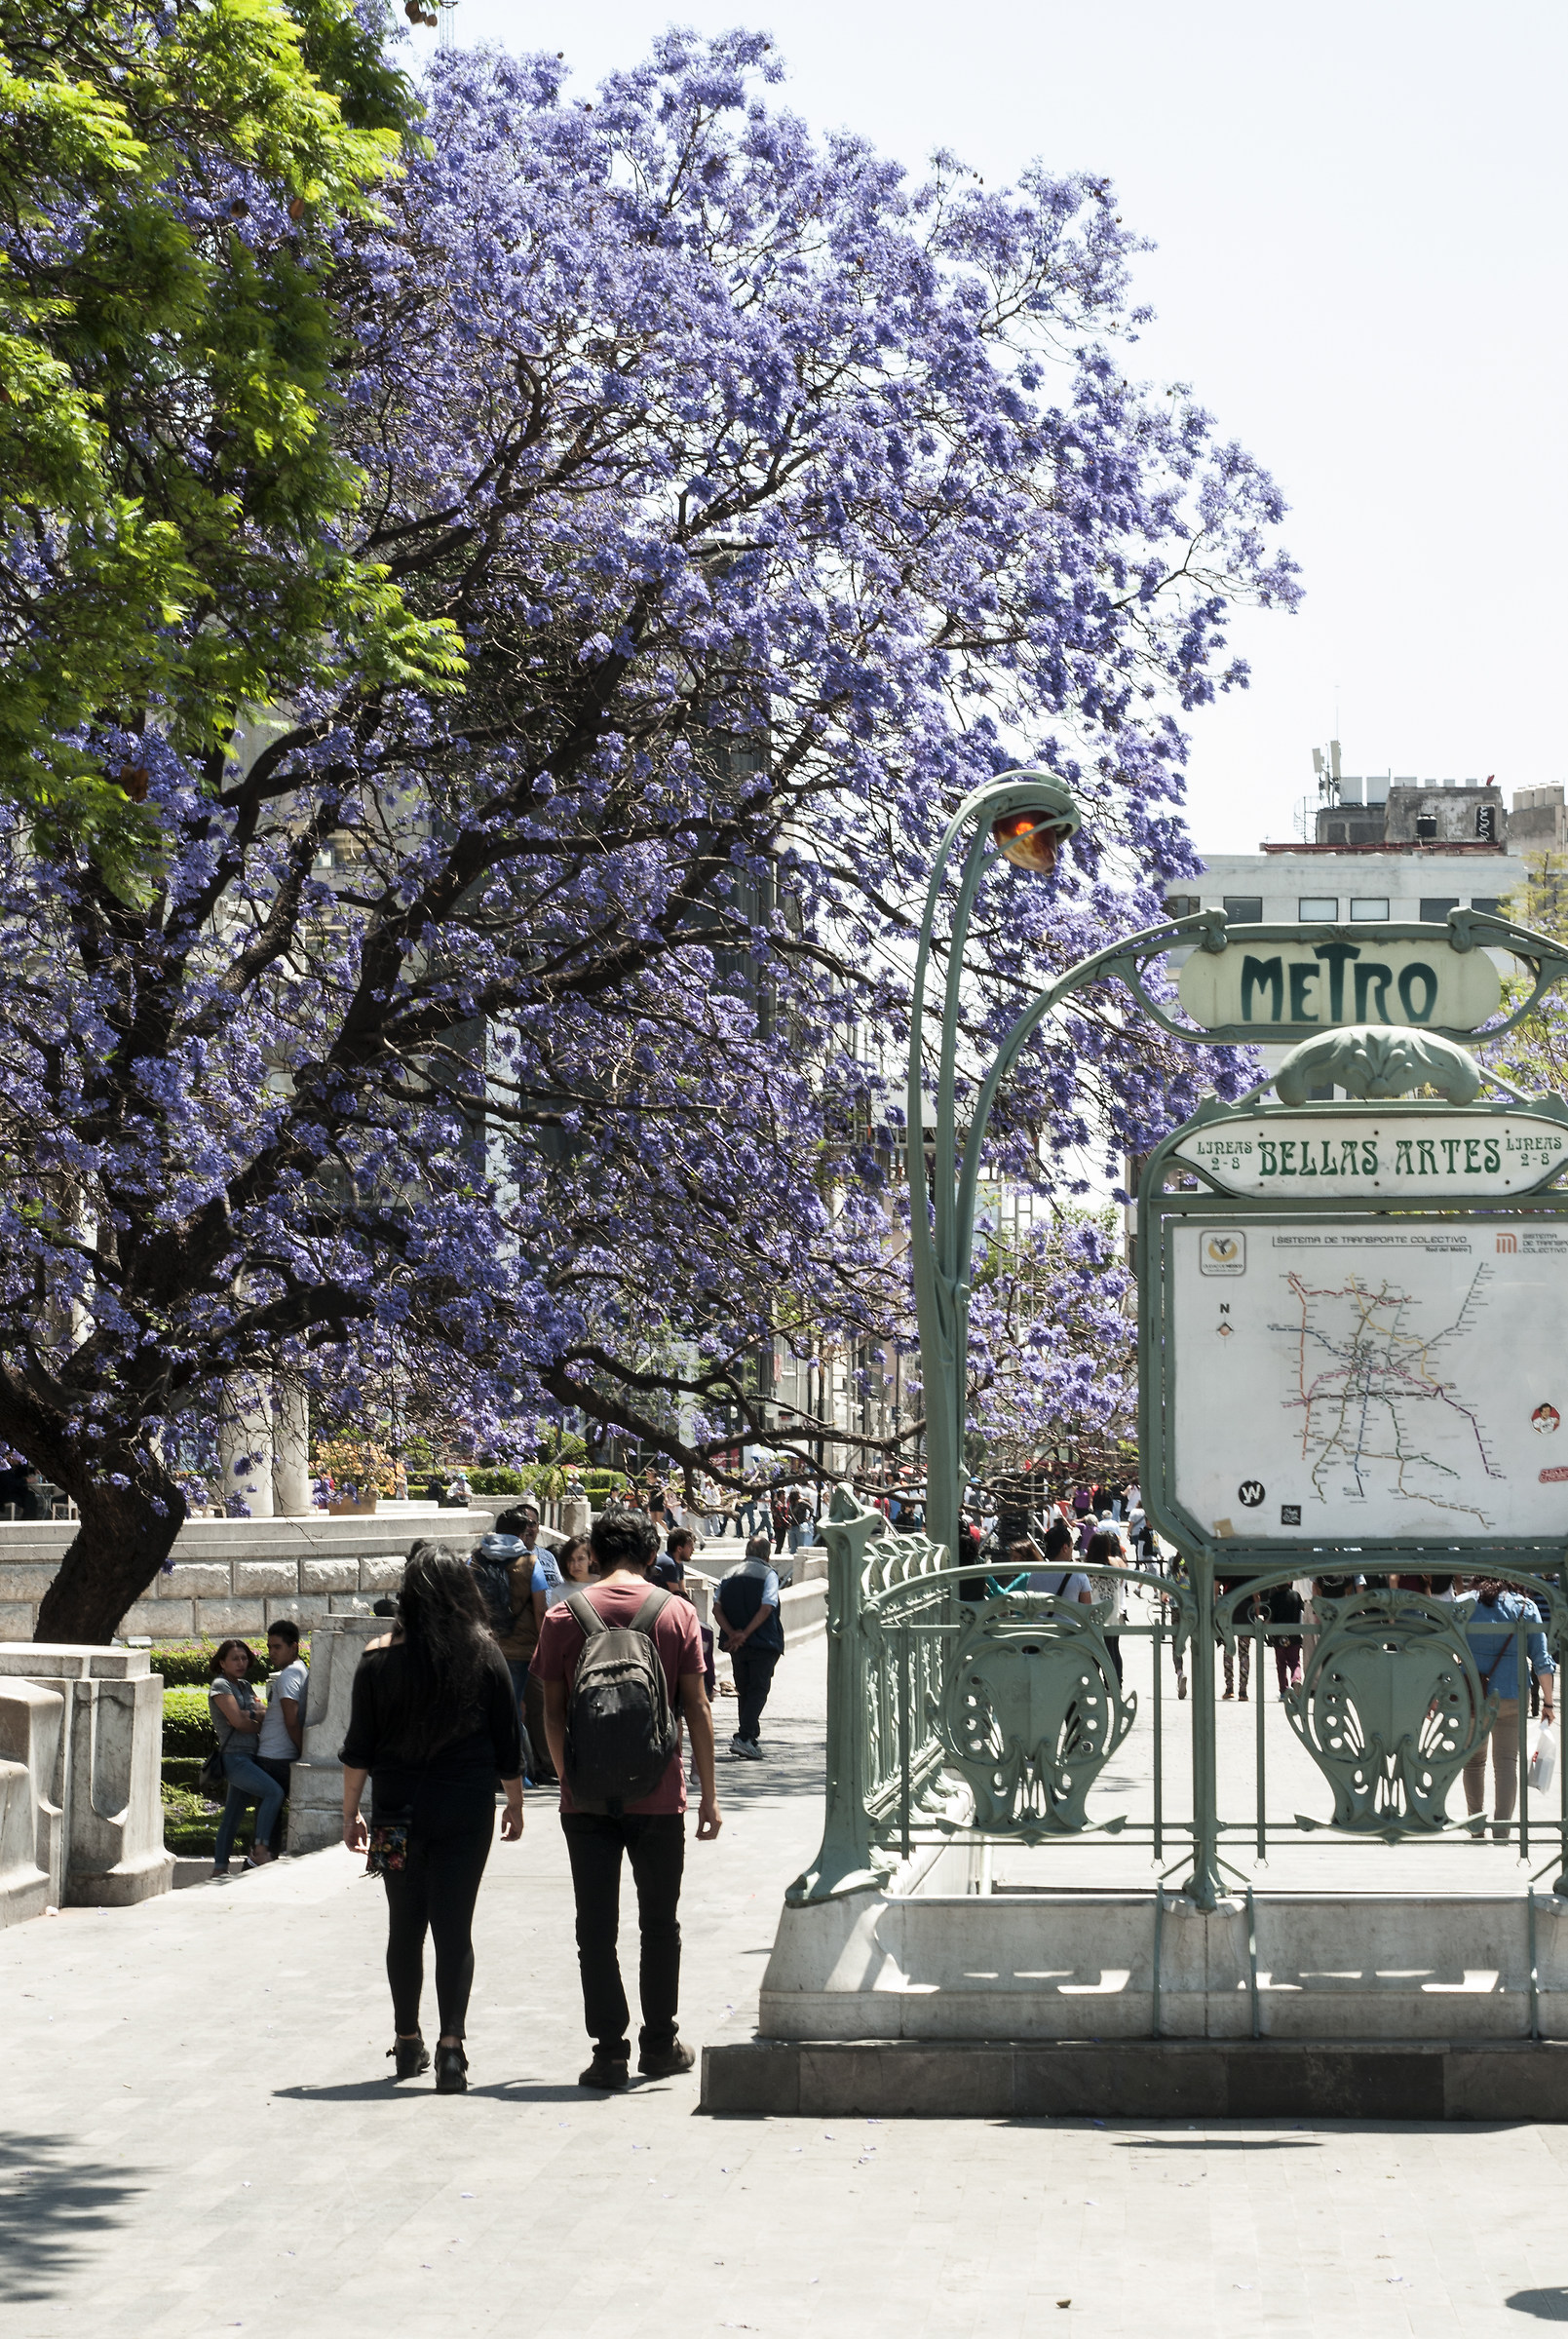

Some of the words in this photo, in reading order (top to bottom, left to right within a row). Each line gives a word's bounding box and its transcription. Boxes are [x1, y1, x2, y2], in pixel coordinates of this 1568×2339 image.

[1240, 941, 1438, 1024] METRO
[1197, 1141, 1253, 1155] LINEAS
[1506, 1136, 1562, 1151] LINEAS
[1211, 1157, 1241, 1170] 2-8
[1257, 1139, 1379, 1176] BELLAS
[1395, 1137, 1502, 1175] ARTES
[1520, 1152, 1550, 1167] 2-8
[1277, 1236, 1321, 1245] SISTEMA
[1324, 1236, 1338, 1245] DE
[1341, 1236, 1407, 1245] TRANSPORTE
[1219, 1303, 1231, 1314] N
